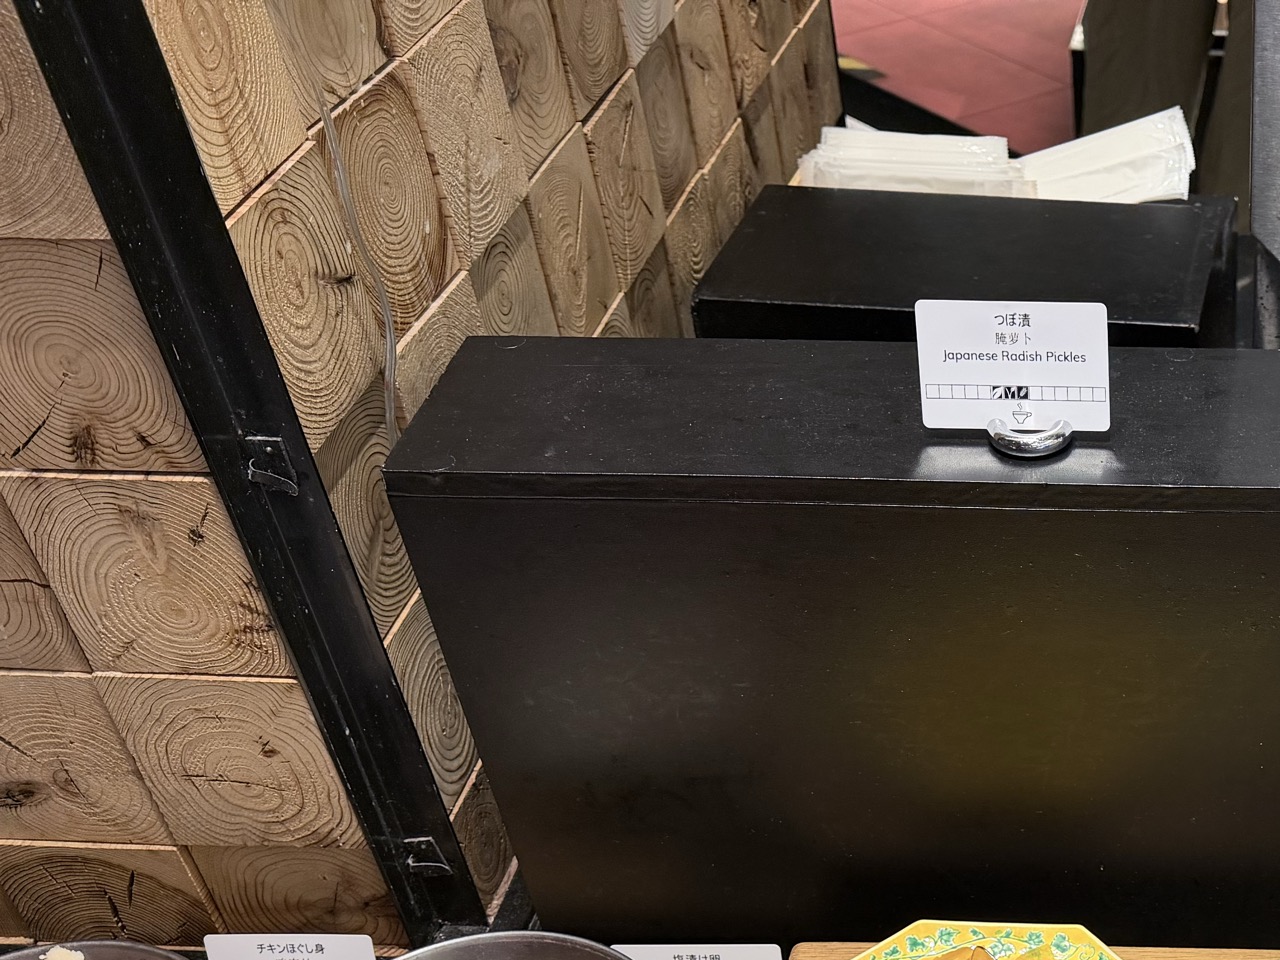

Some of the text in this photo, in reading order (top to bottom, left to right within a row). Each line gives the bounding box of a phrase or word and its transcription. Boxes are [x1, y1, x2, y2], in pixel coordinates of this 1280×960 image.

[994, 313, 1031, 327] つぼ漬
[943, 350, 1087, 363] Japanese Radish Pickles
[257, 943, 325, 954] チキンほぐし身
